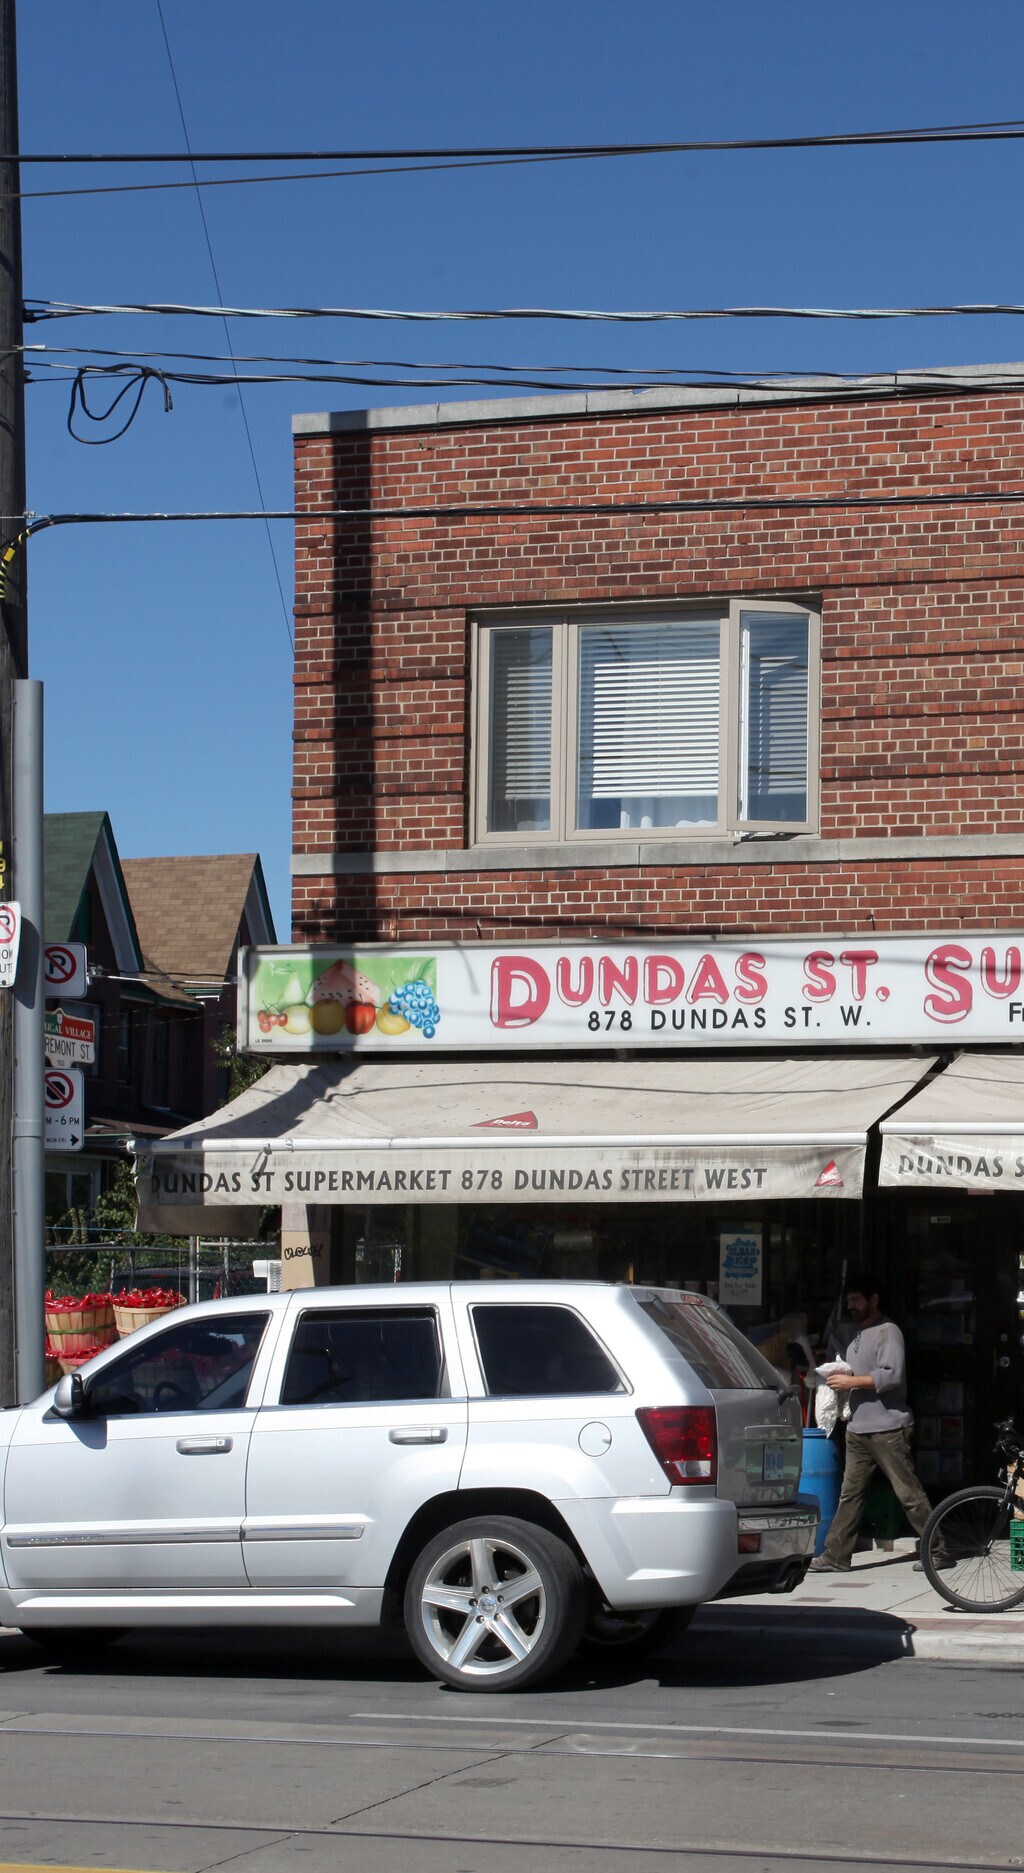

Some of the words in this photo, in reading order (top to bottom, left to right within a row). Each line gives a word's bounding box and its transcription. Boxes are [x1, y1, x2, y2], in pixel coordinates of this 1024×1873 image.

[490, 952, 768, 1029] DUNDAS
[802, 950, 891, 1003] ST.
[587, 1009, 633, 1032] 878
[651, 1007, 767, 1031] DUNDAS
[784, 1006, 821, 1028] ST.
[840, 1005, 872, 1027] W.
[45, 1022, 62, 1034] UGAL
[65, 1026, 92, 1039] VILLAGE
[45, 1037, 75, 1057] REMONT
[61, 1115, 66, 1125] 6
[69, 1117, 79, 1125] PM
[900, 1155, 1004, 1178] DUNDAS
[151, 1172, 241, 1193] DUNDAS
[251, 1171, 275, 1192] ST
[284, 1170, 452, 1192] SUPERMARKET
[461, 1170, 503, 1191] 878
[514, 1169, 613, 1191] DUNDAS
[620, 1169, 694, 1190] STREET
[704, 1168, 767, 1190] WEST
